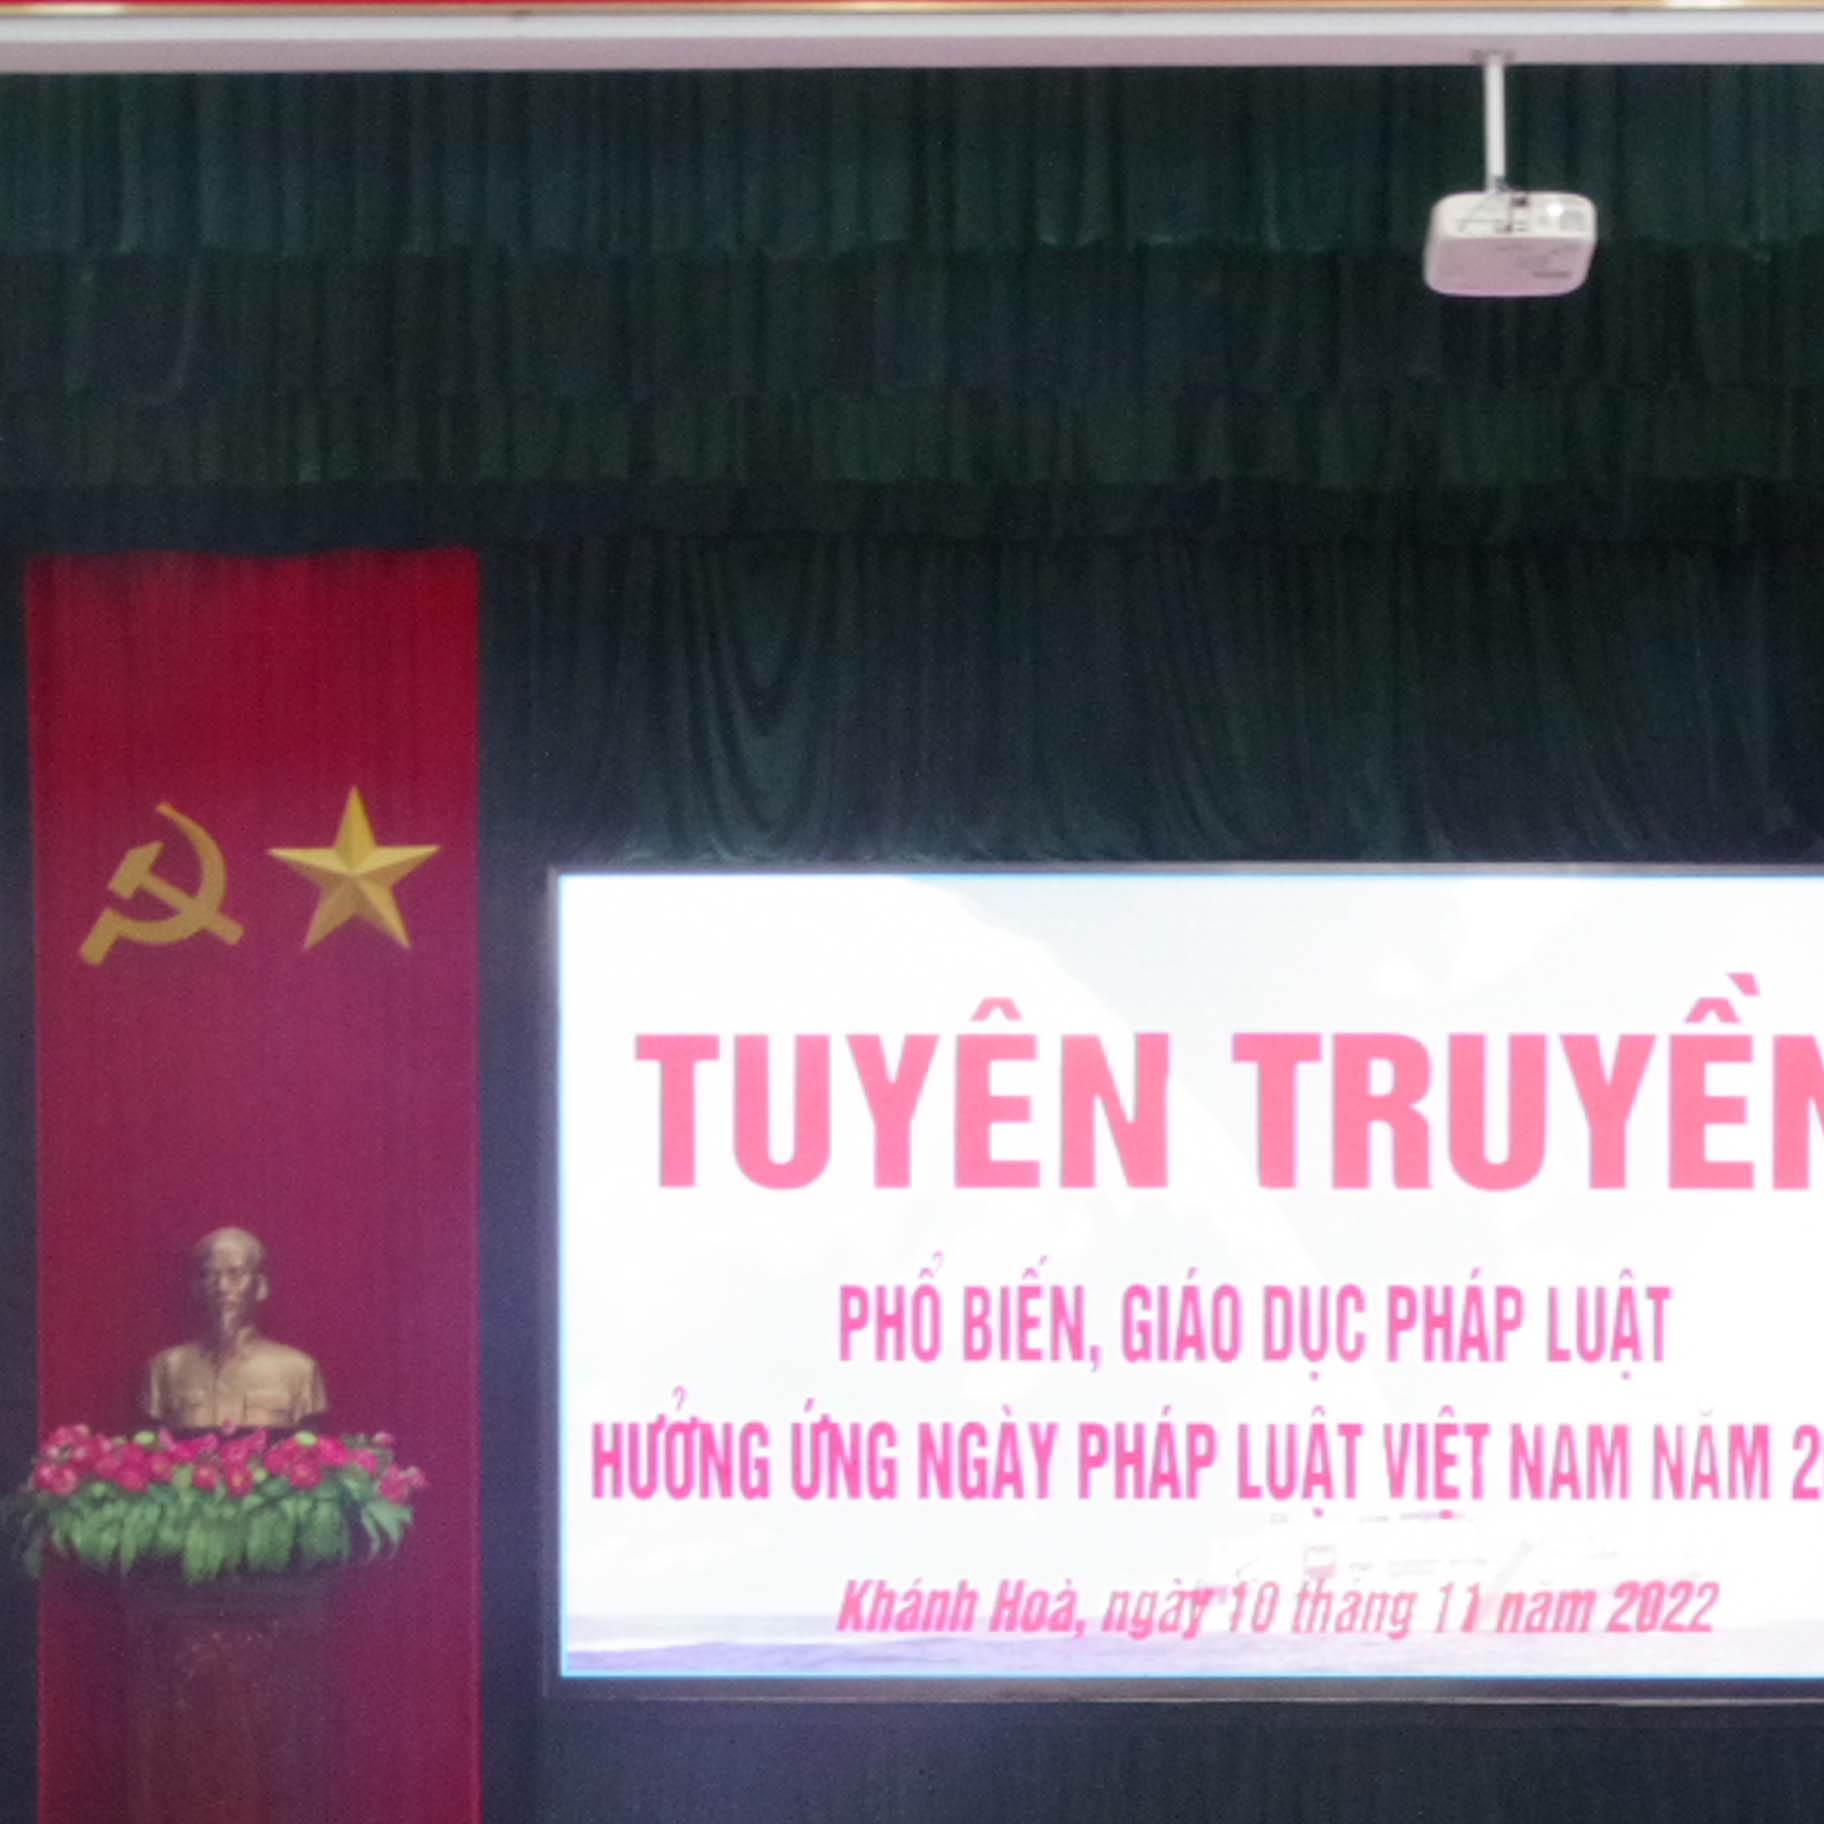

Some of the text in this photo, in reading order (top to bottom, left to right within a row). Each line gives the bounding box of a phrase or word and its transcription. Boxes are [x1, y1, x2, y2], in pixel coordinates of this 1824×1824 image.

[634, 997, 1172, 1191] TUYÊN
[838, 1250, 1674, 1381] PHỔ BIẾN, GIÁO DỤC PHÁP LUẬT
[588, 1385, 772, 1501] HƯỞNG
[791, 1397, 900, 1502] ỨNG
[916, 1403, 1061, 1501] NGÀY
[1076, 1405, 1220, 1501] PHÁP
[1236, 1405, 1365, 1517] LUẬT
[1384, 1404, 1492, 1520] VIỆT
[1508, 1423, 1631, 1501] NAM
[1654, 1407, 1772, 1501] NĂM
[837, 1578, 977, 1634] Khánh
[986, 1578, 1089, 1645] Hoà,
[1229, 1580, 1280, 1633] 10
[1434, 1583, 1484, 1638] 11
[1606, 1579, 1720, 1635] 2022
